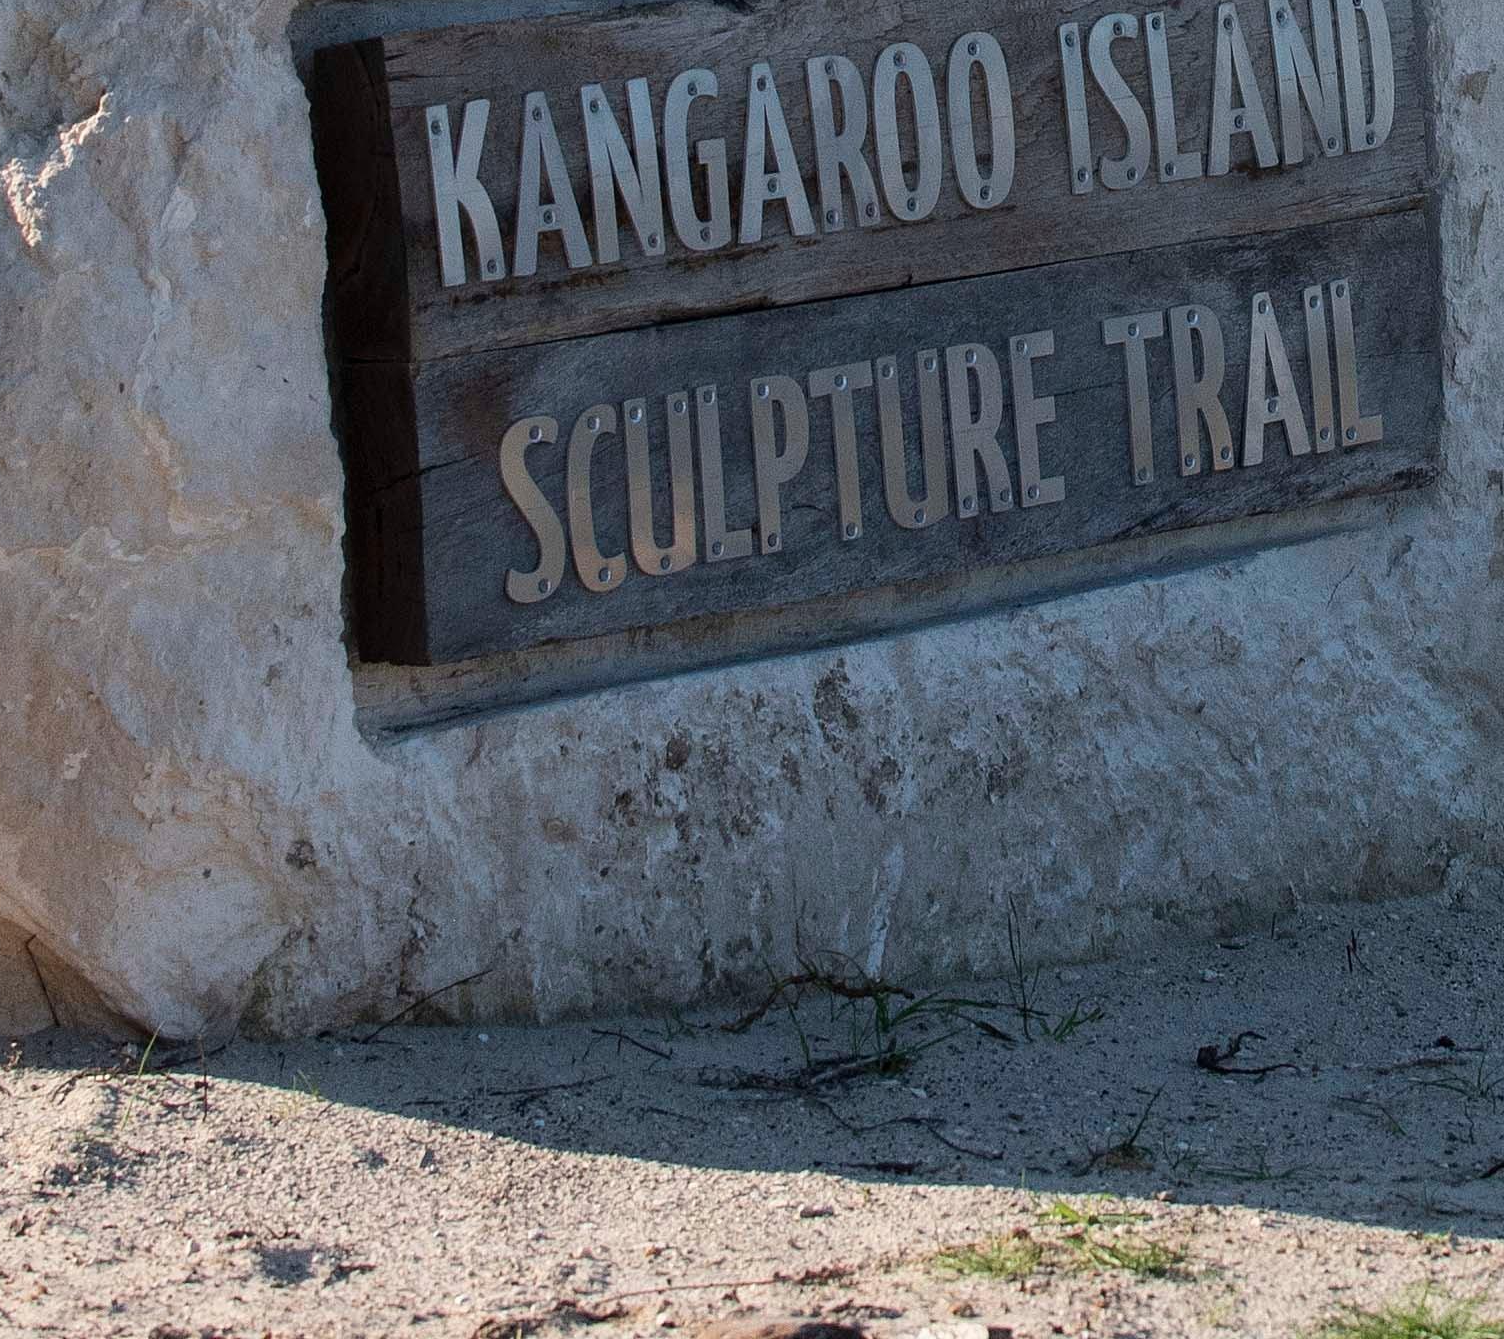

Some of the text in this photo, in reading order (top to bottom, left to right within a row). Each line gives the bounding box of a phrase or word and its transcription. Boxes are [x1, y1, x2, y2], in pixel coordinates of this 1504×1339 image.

[424, 30, 1017, 288] KANGAROO
[499, 278, 1383, 606] SCULPTURE TRAIL
